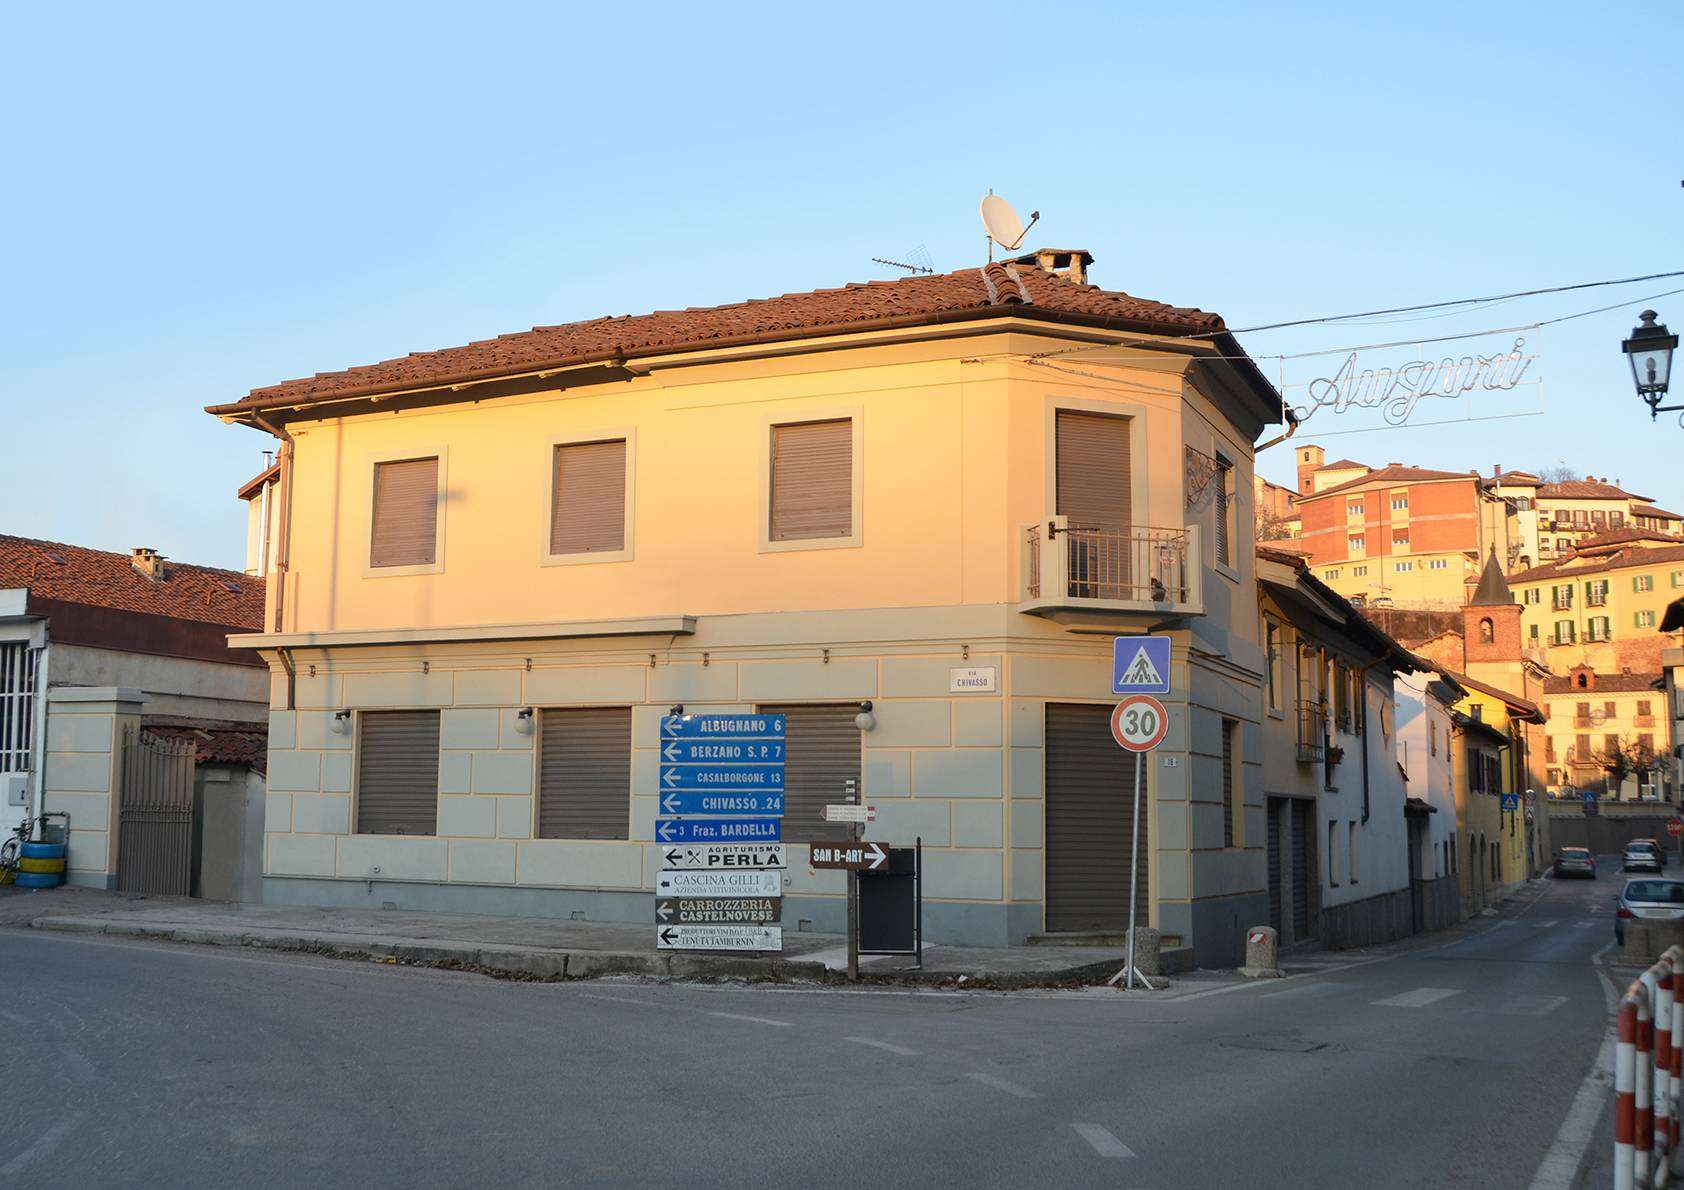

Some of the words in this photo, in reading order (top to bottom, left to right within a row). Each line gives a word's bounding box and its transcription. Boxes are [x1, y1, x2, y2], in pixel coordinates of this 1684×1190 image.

[1294, 337, 1531, 425] Auguri
[957, 678, 988, 687] CHIVASSO
[701, 720, 765, 731] ALBUGNANO
[775, 720, 781, 731] 6
[1125, 710, 1156, 737] 30
[691, 746, 741, 757] BERZANO
[748, 746, 758, 757] S.
[761, 746, 768, 757] P.
[775, 746, 781, 757] 7
[697, 773, 764, 783] CASALBORGONE
[771, 773, 781, 783] 13
[703, 798, 757, 809] CHIVASSO
[767, 798, 780, 809] 24
[679, 825, 685, 836] 3
[693, 825, 718, 837] Fraz.
[721, 824, 776, 836] BARDELLA
[708, 854, 780, 866] PERLA
[813, 849, 831, 862] SAN
[834, 849, 862, 862] B-ART
[674, 875, 725, 886] CASCINA
[729, 875, 759, 886] GILLI
[709, 886, 759, 894] VITIVINICOLA
[680, 900, 773, 911] CARROZZERIA
[680, 911, 774, 921] CASTELNOVESE
[682, 937, 709, 945] TENUTA
